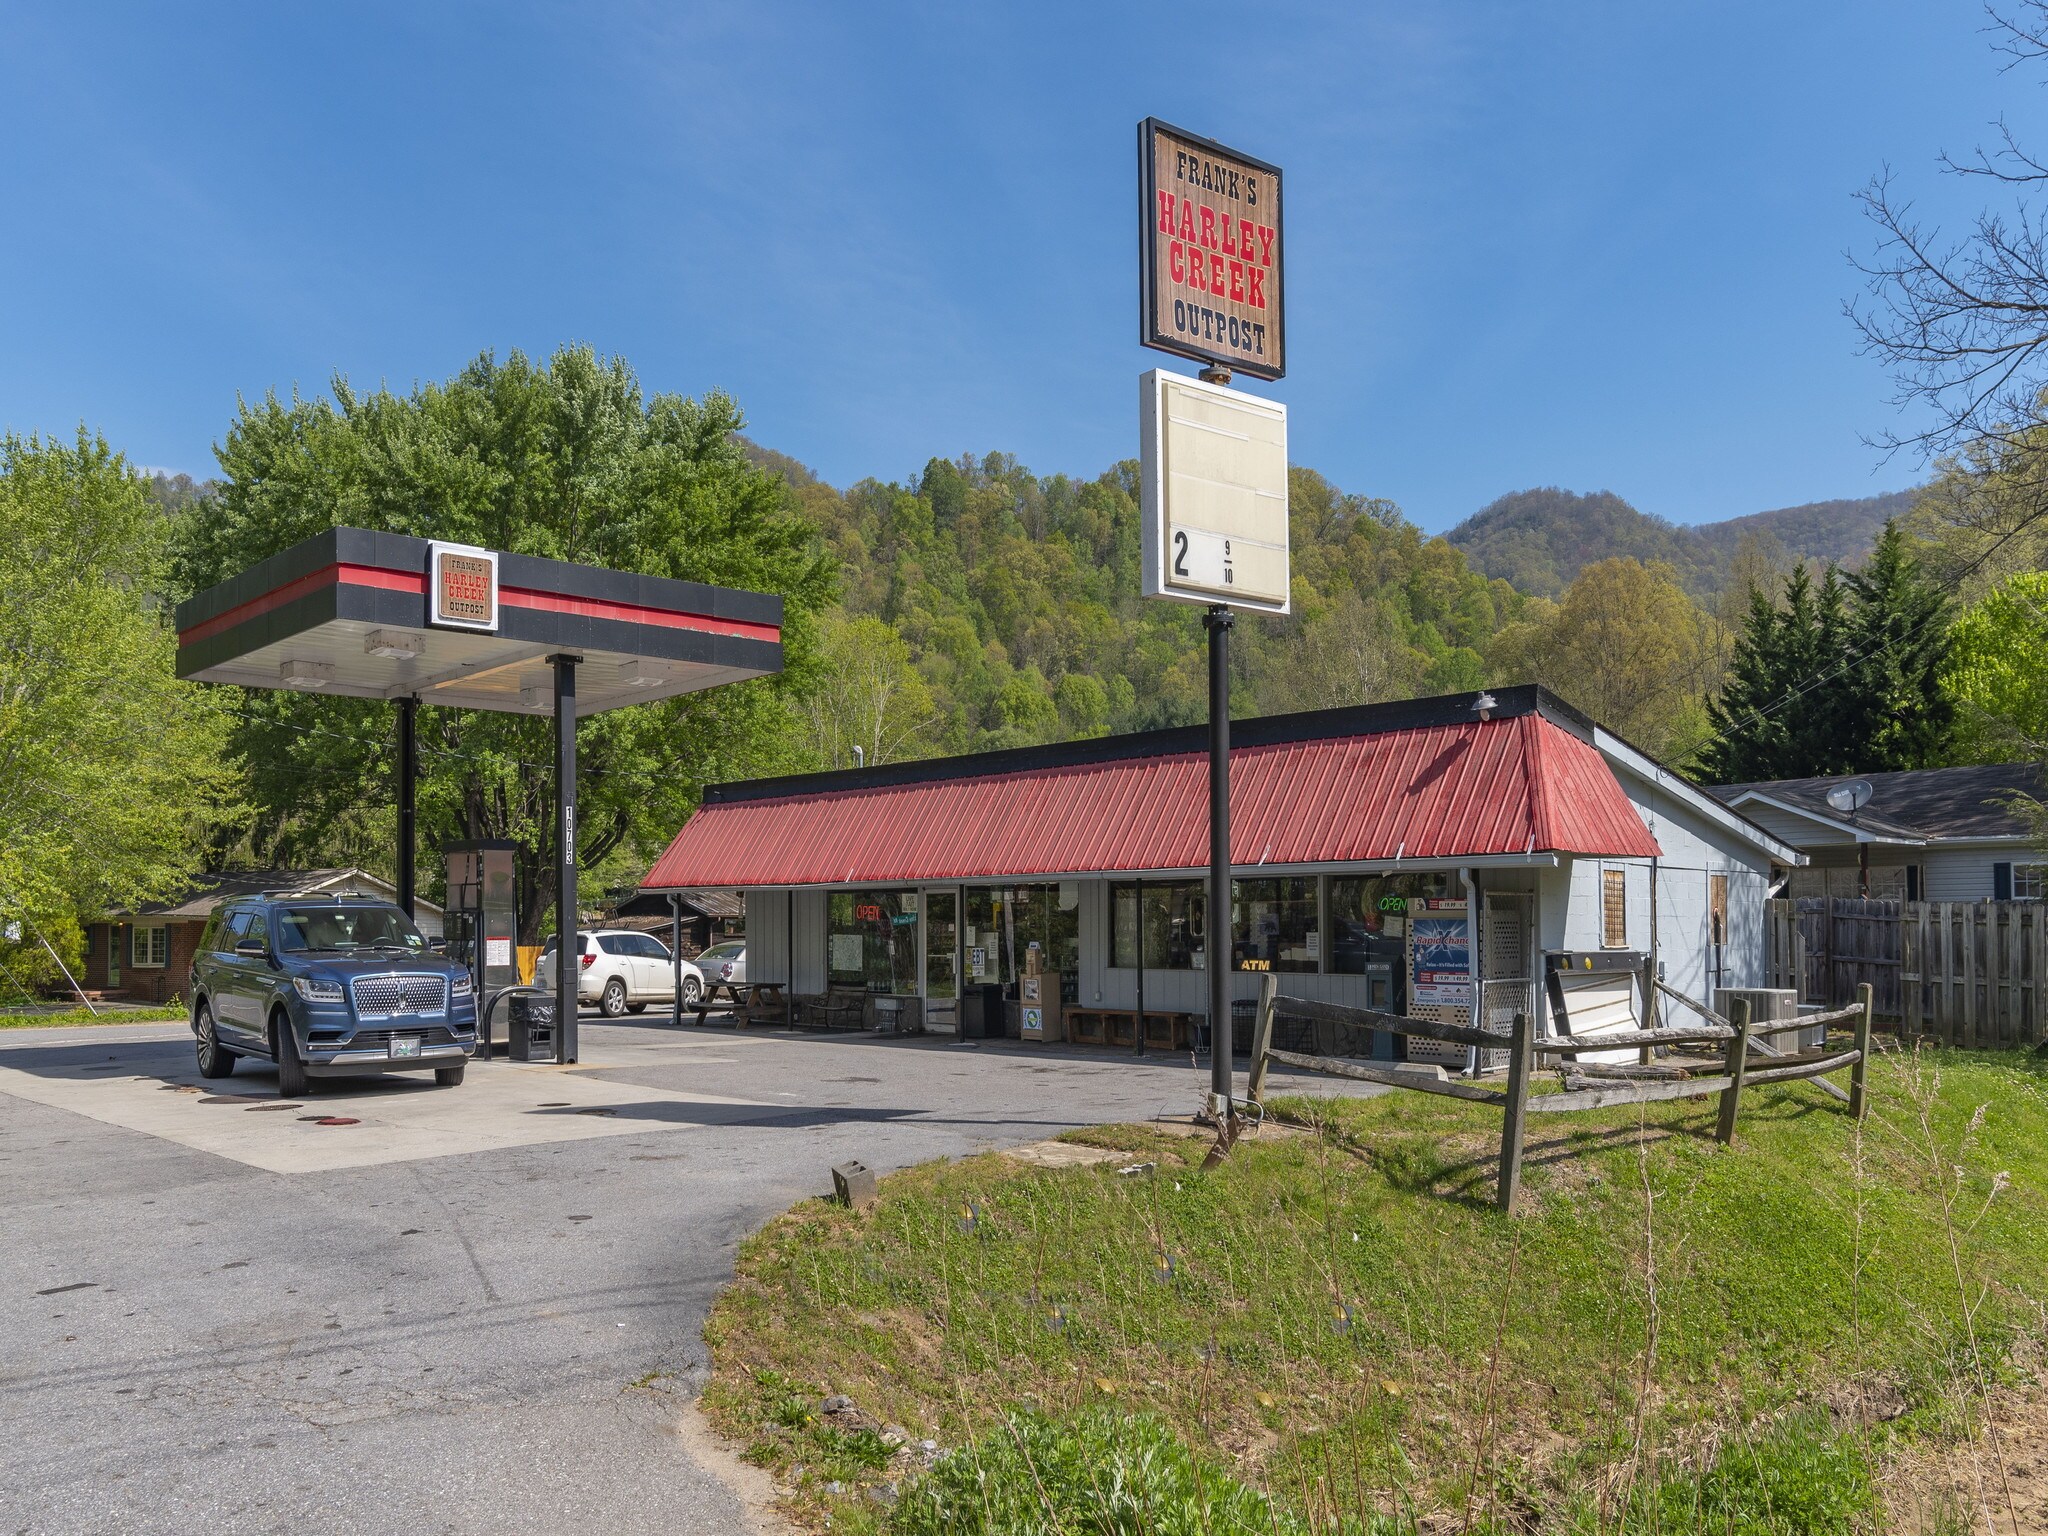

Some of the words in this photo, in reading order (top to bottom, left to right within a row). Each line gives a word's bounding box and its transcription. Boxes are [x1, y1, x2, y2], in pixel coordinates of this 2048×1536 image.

[1177, 150, 1257, 206] FRANK'S
[1158, 189, 1275, 267] HARLEY
[1170, 240, 1266, 309] CREEK
[1174, 299, 1265, 355] OUTPOST
[1175, 531, 1189, 577] 2
[1225, 540, 1231, 556] 9
[451, 560, 483, 572] FRANK'S
[444, 571, 489, 589] HARLEY
[1224, 568, 1233, 584] 10
[448, 585, 485, 601] CREEK
[449, 601, 485, 614] OUTPOST
[1379, 897, 1408, 911] OPEN
[1241, 959, 1271, 971] ATM
